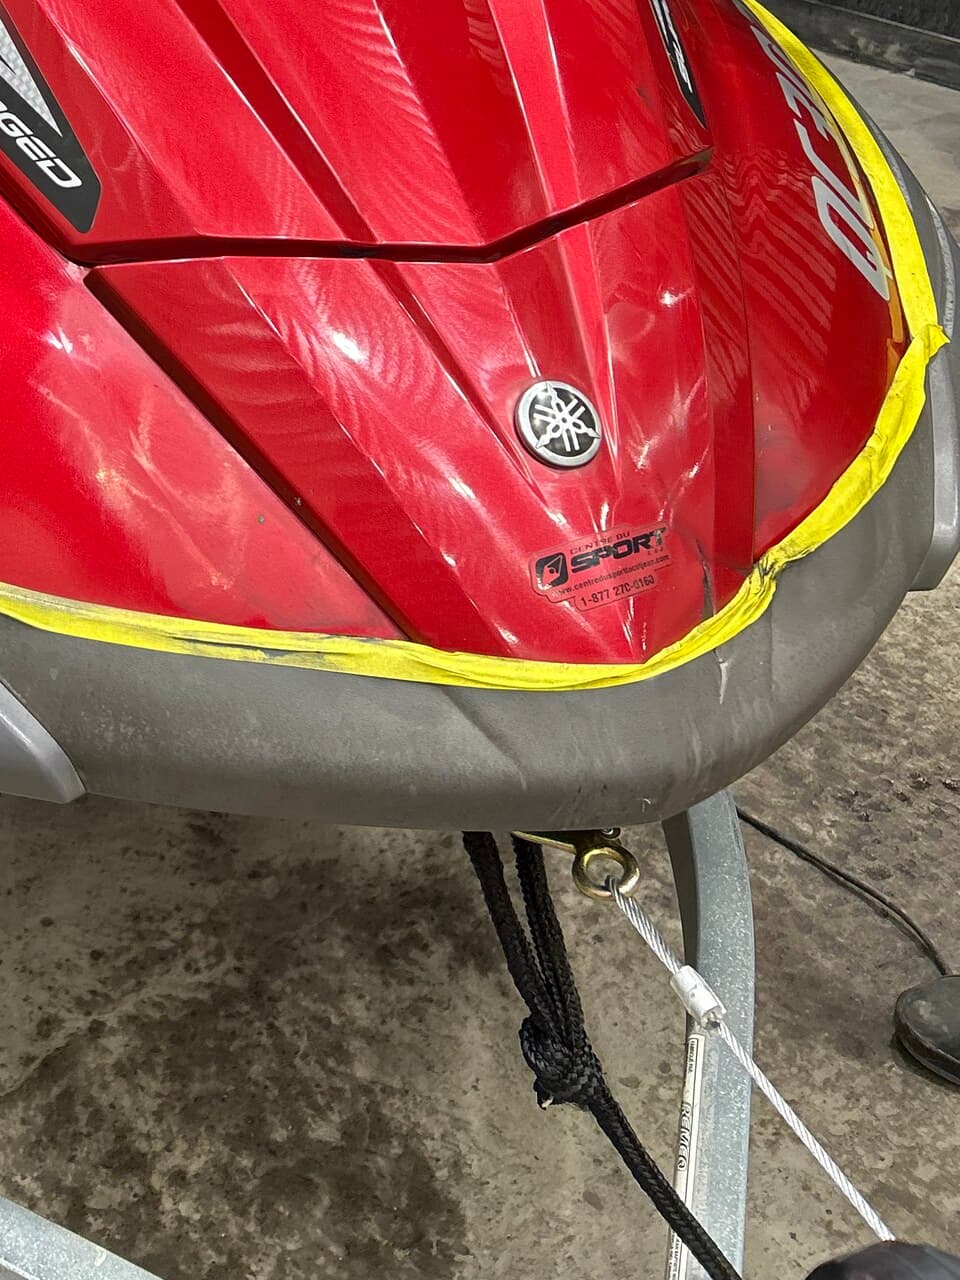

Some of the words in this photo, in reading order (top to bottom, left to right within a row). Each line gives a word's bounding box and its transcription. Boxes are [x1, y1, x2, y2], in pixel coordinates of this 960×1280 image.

[616, 531, 630, 540] DU
[571, 527, 667, 574] SPORT
[581, 589, 610, 606] 1-877
